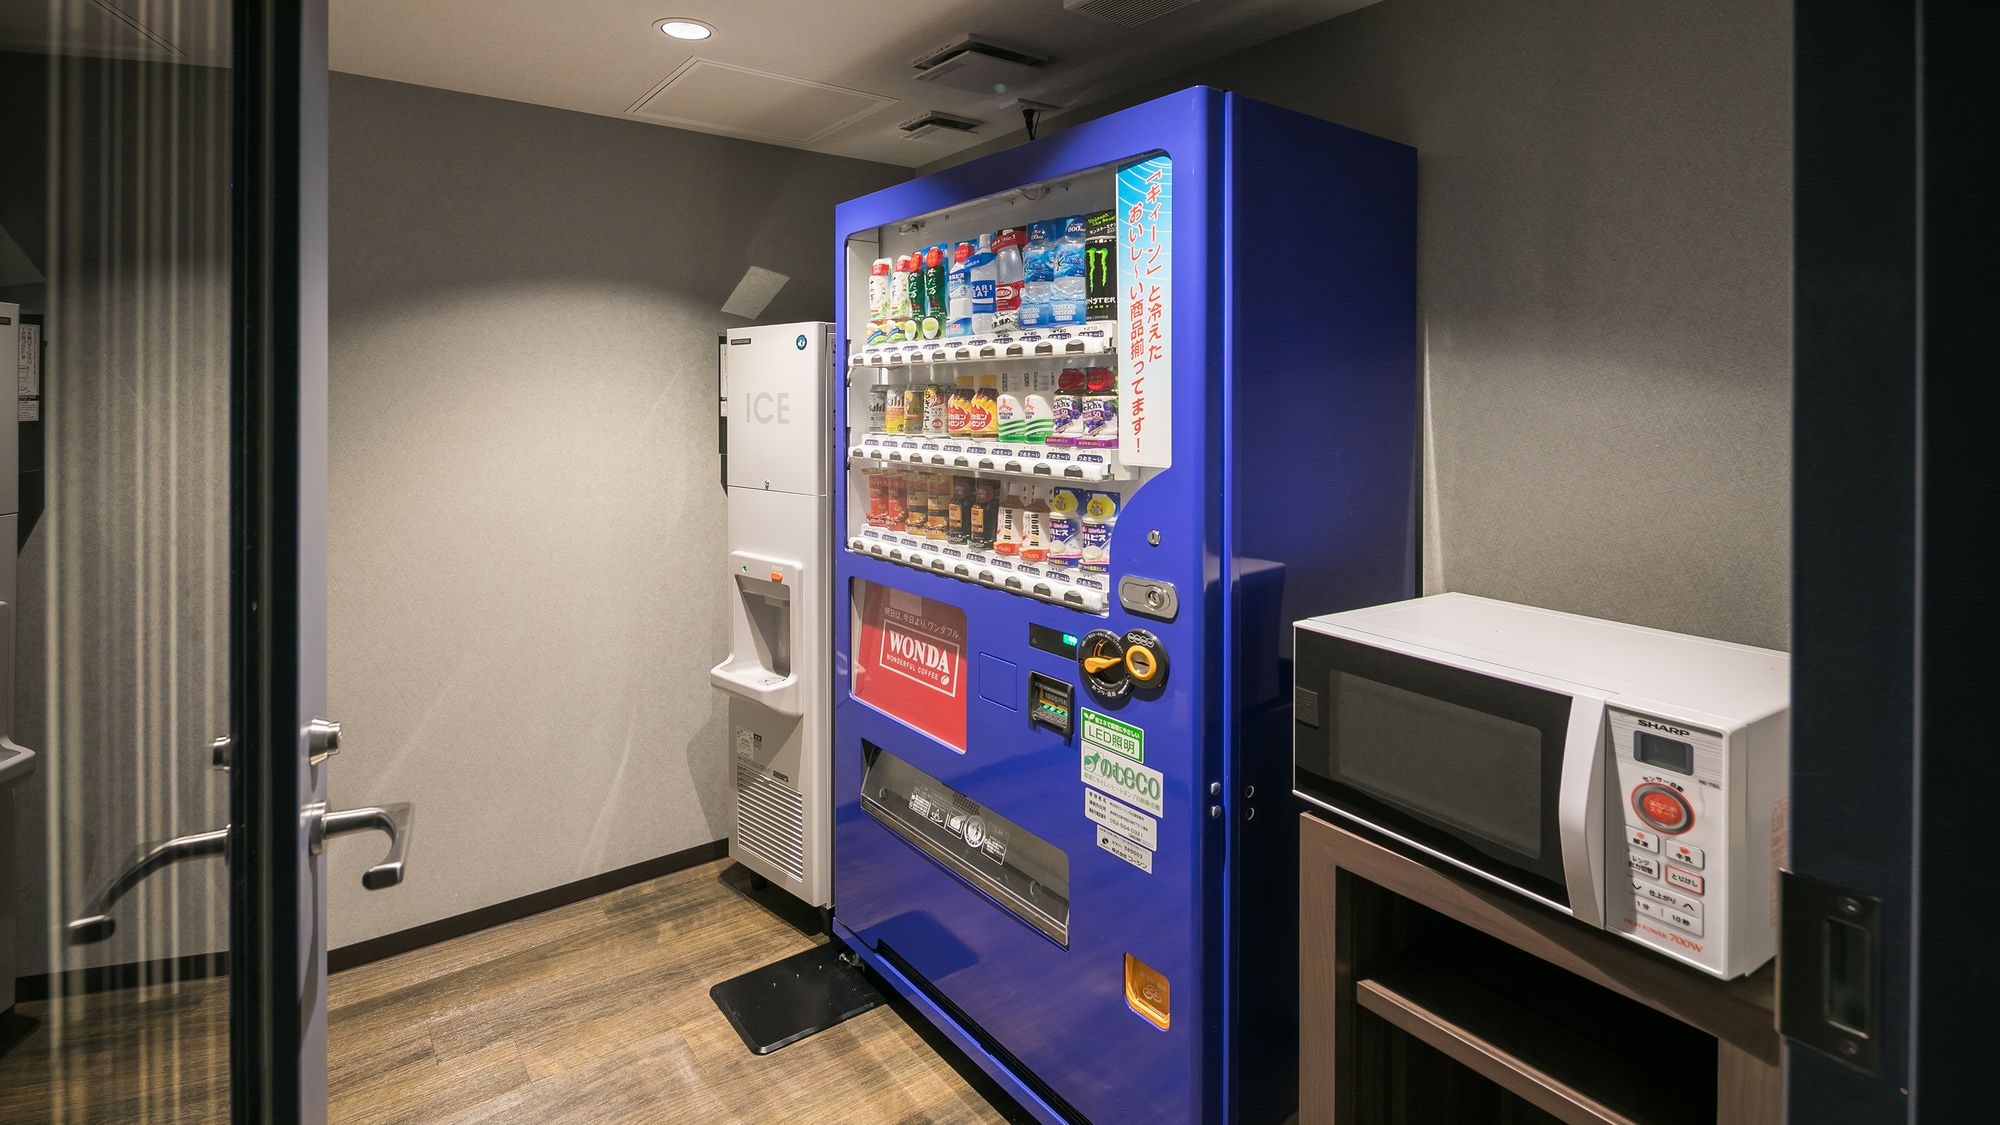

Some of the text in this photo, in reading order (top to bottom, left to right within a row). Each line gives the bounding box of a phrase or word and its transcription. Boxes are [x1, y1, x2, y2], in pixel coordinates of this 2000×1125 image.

[746, 391, 790, 425] ICE
[886, 653, 939, 681] WONDERFUL COFFEE
[888, 630, 950, 675] WONDA
[1088, 725, 1135, 755] LED照明
[1637, 719, 1690, 736] SHARP
[1669, 932, 1703, 953] 700W
